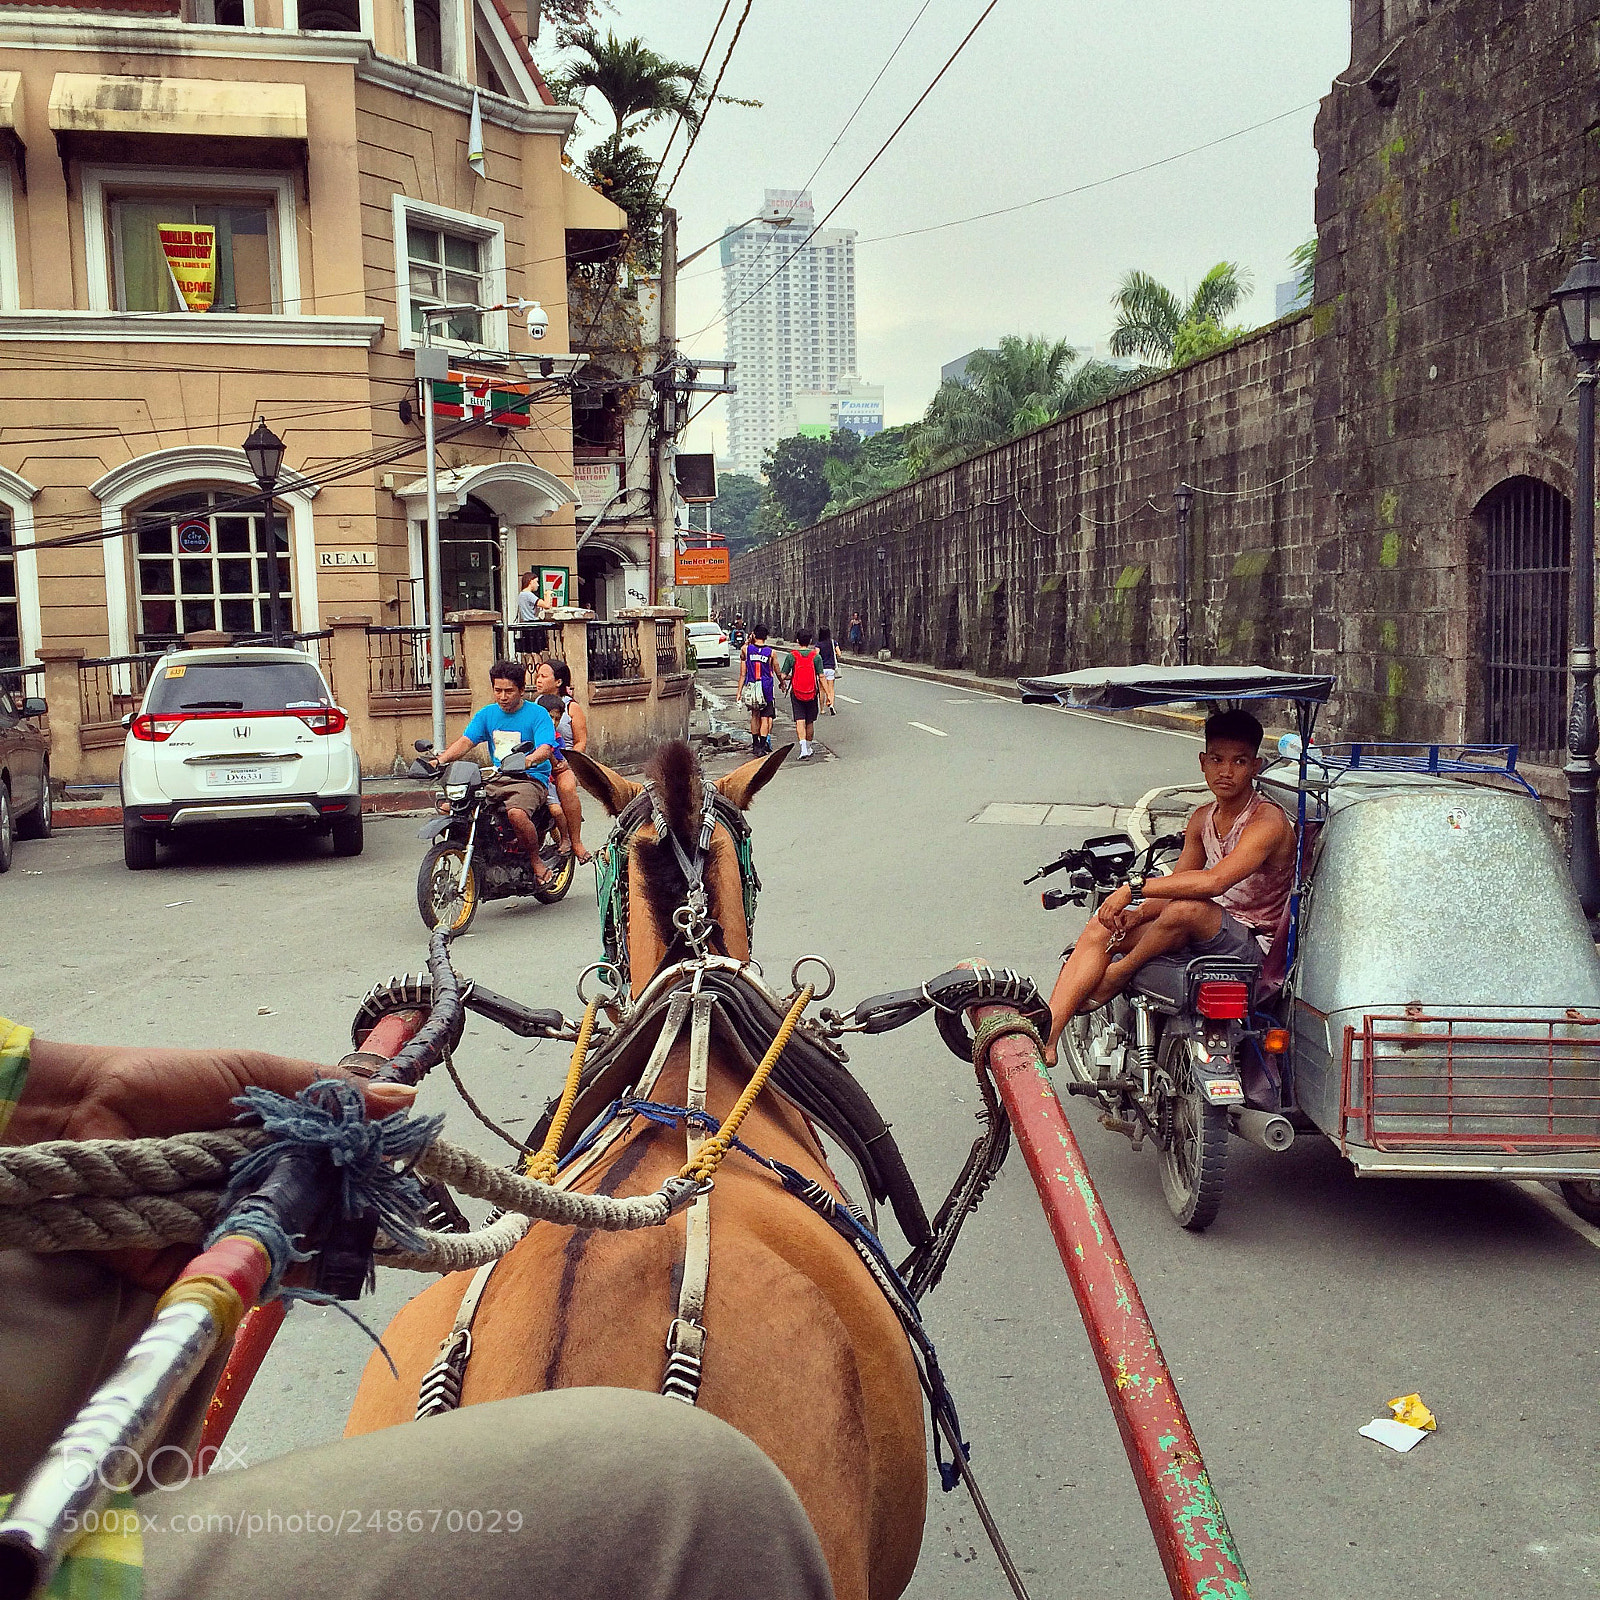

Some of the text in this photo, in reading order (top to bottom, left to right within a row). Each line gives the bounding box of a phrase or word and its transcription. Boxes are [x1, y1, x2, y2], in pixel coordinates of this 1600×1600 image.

[194, 231, 213, 245] CITY
[176, 280, 212, 293] ELCOME
[593, 466, 611, 475] CITY
[322, 553, 374, 565] REAL
